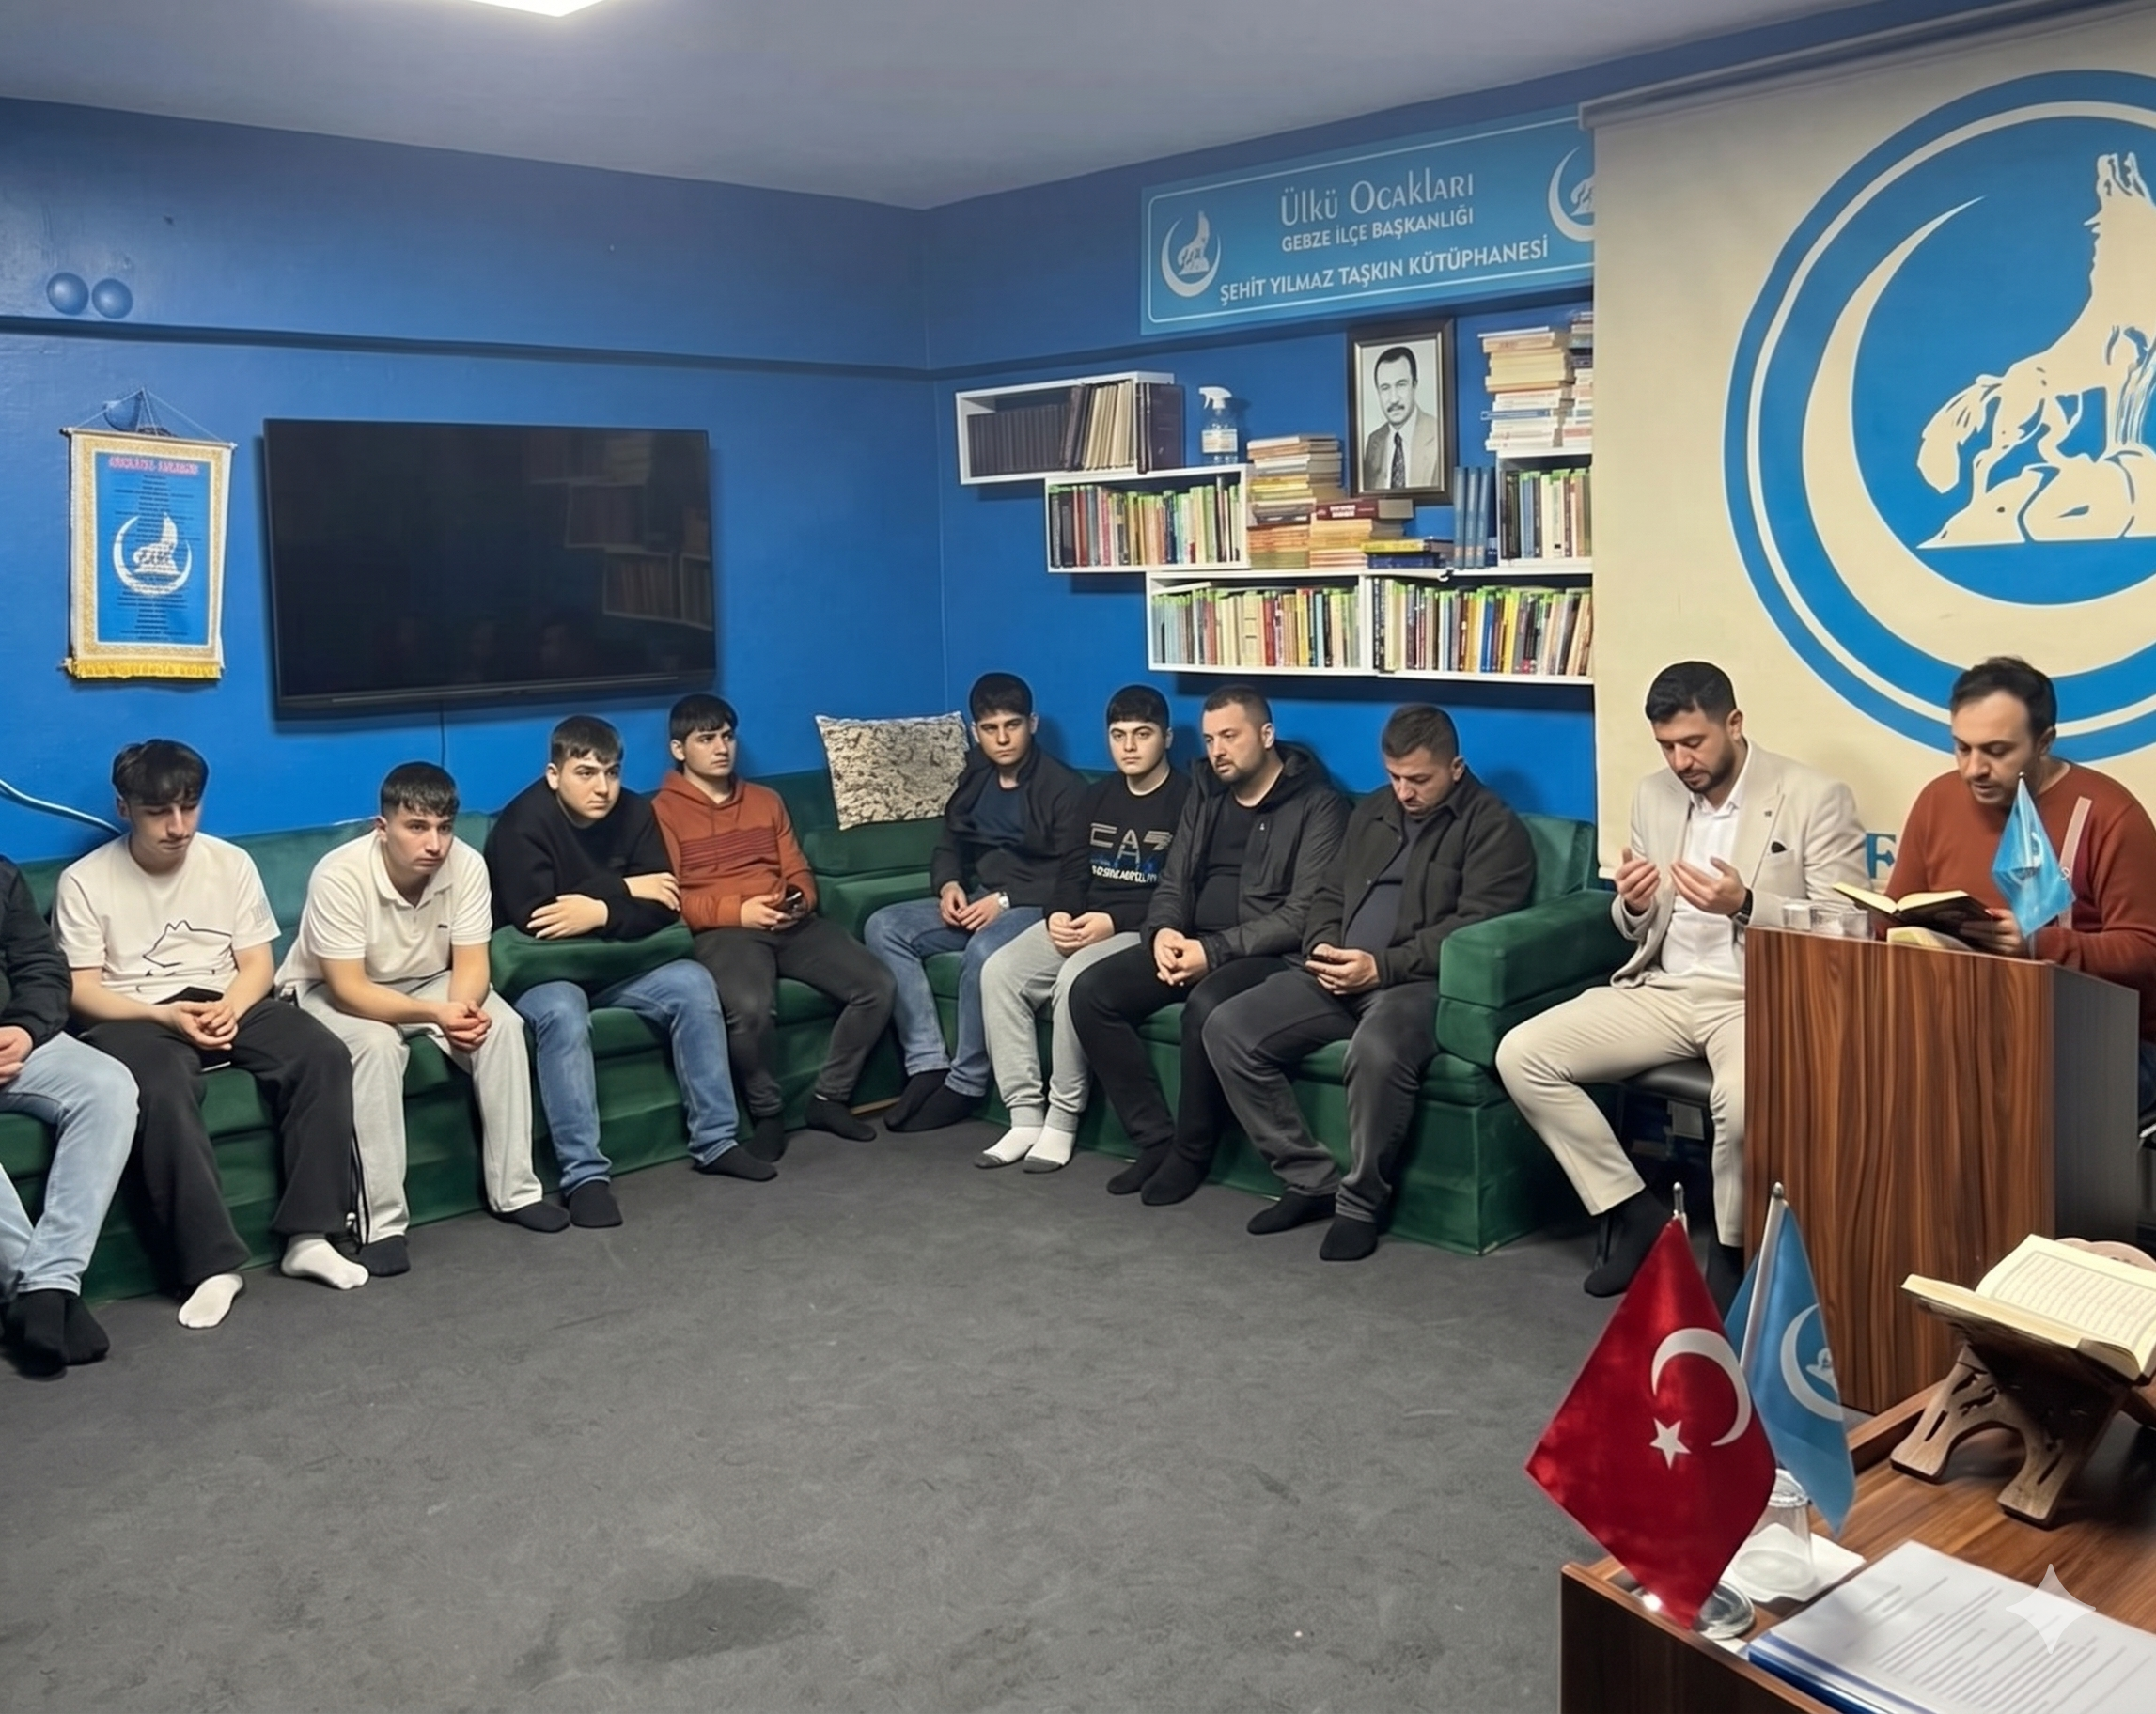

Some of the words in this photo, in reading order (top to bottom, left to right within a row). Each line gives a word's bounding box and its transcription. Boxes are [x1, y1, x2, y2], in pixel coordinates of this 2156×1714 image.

[1281, 186, 1338, 226] Ülkü
[1281, 229, 1332, 252] GEBZE
[1336, 224, 1367, 247] İLÇE
[1372, 204, 1474, 240] BAŞKANLIĞI
[1220, 276, 1267, 306] ŞEHİT
[1270, 269, 1334, 295] YILMAZ
[1338, 258, 1403, 288] TAŞKIN
[1409, 233, 1548, 276] KÜTÜPHANESİ
